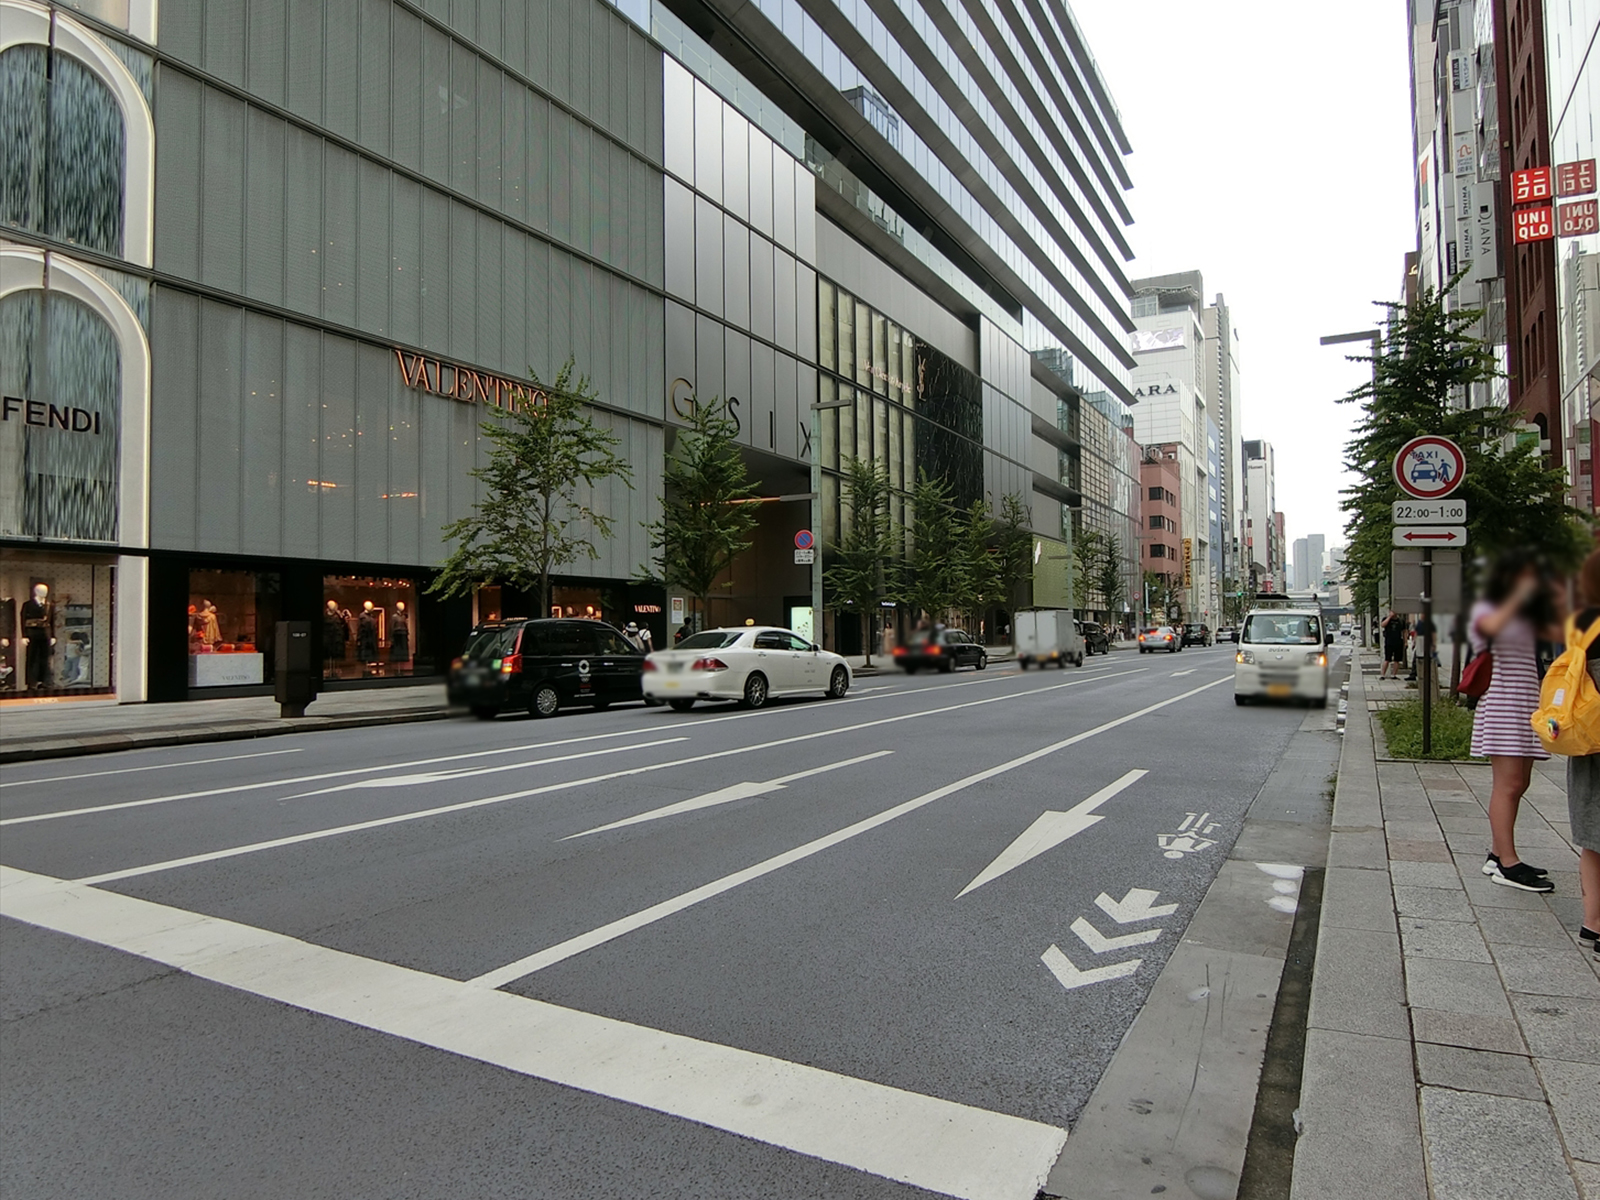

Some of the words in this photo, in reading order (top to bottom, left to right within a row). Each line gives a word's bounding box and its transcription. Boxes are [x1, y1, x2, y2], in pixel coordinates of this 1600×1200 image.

[1516, 170, 1546, 186] ユニ
[1517, 184, 1547, 199] クロ
[1518, 210, 1545, 225] UNI
[1479, 205, 1492, 255] DIANA
[1518, 223, 1549, 239] QLO
[396, 350, 549, 418] VALENTINO
[3, 396, 100, 435] FENDI
[1411, 451, 1438, 459] TAXI
